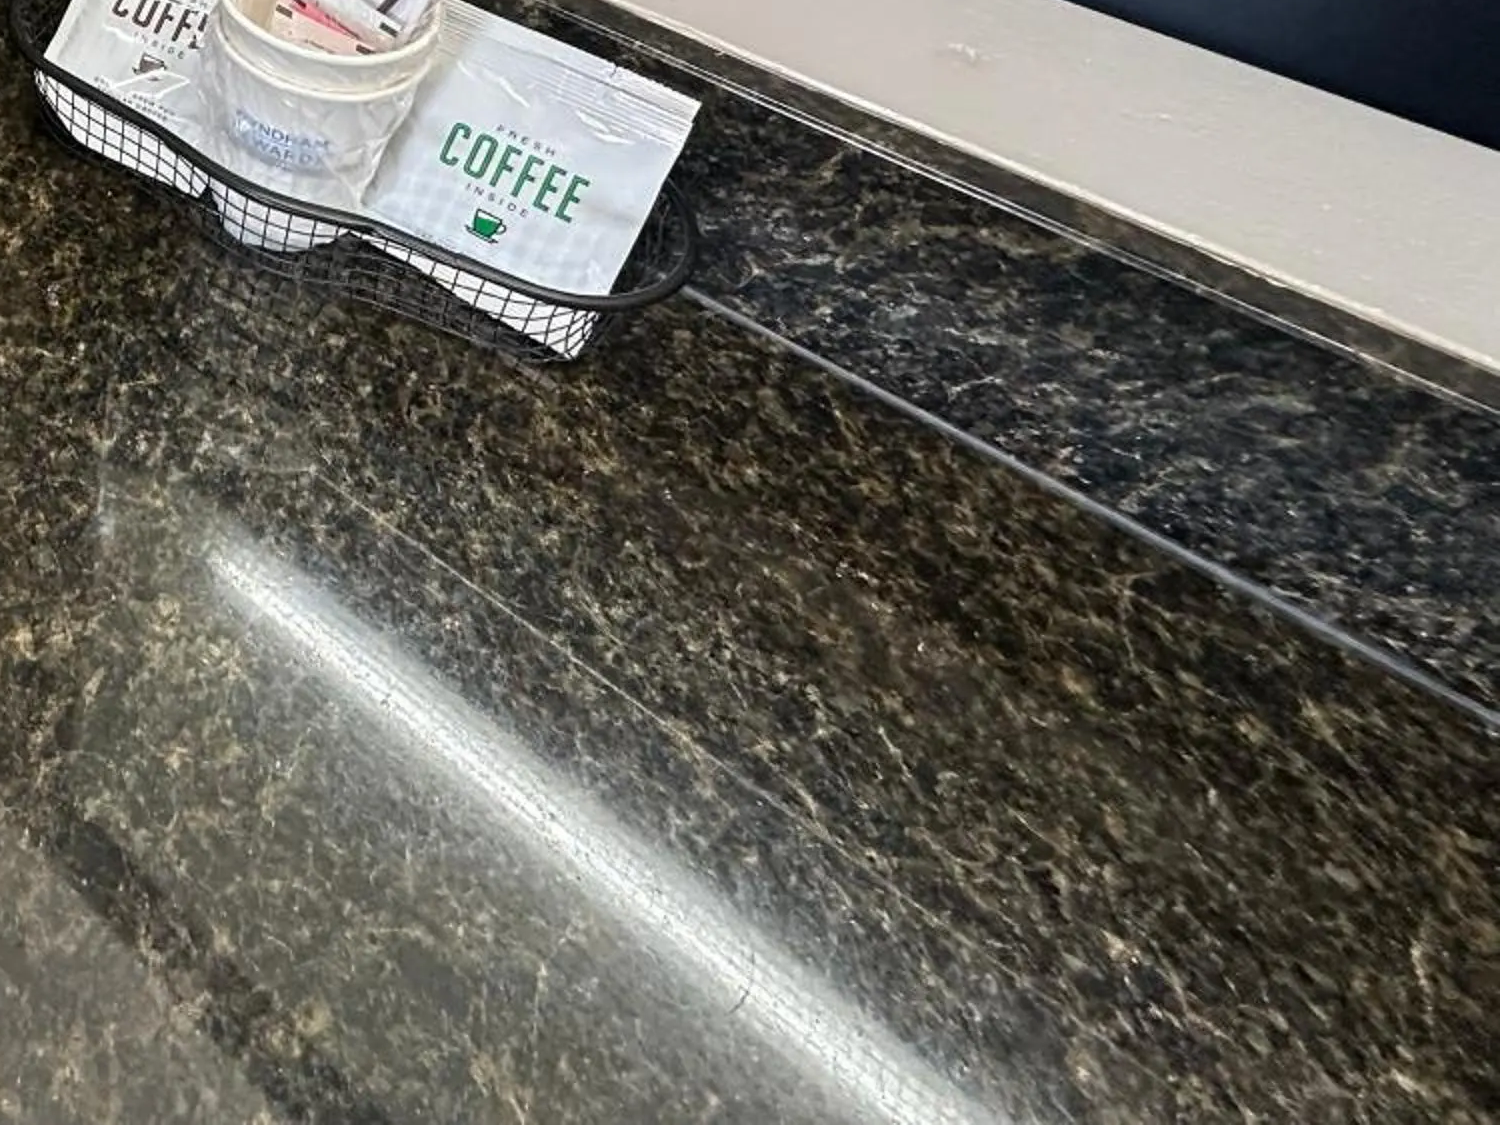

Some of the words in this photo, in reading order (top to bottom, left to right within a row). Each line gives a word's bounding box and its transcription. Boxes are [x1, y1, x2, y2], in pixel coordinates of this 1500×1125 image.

[495, 124, 557, 157] FRESH
[439, 122, 591, 224] COFFEE
[464, 183, 530, 218] INSIDE
